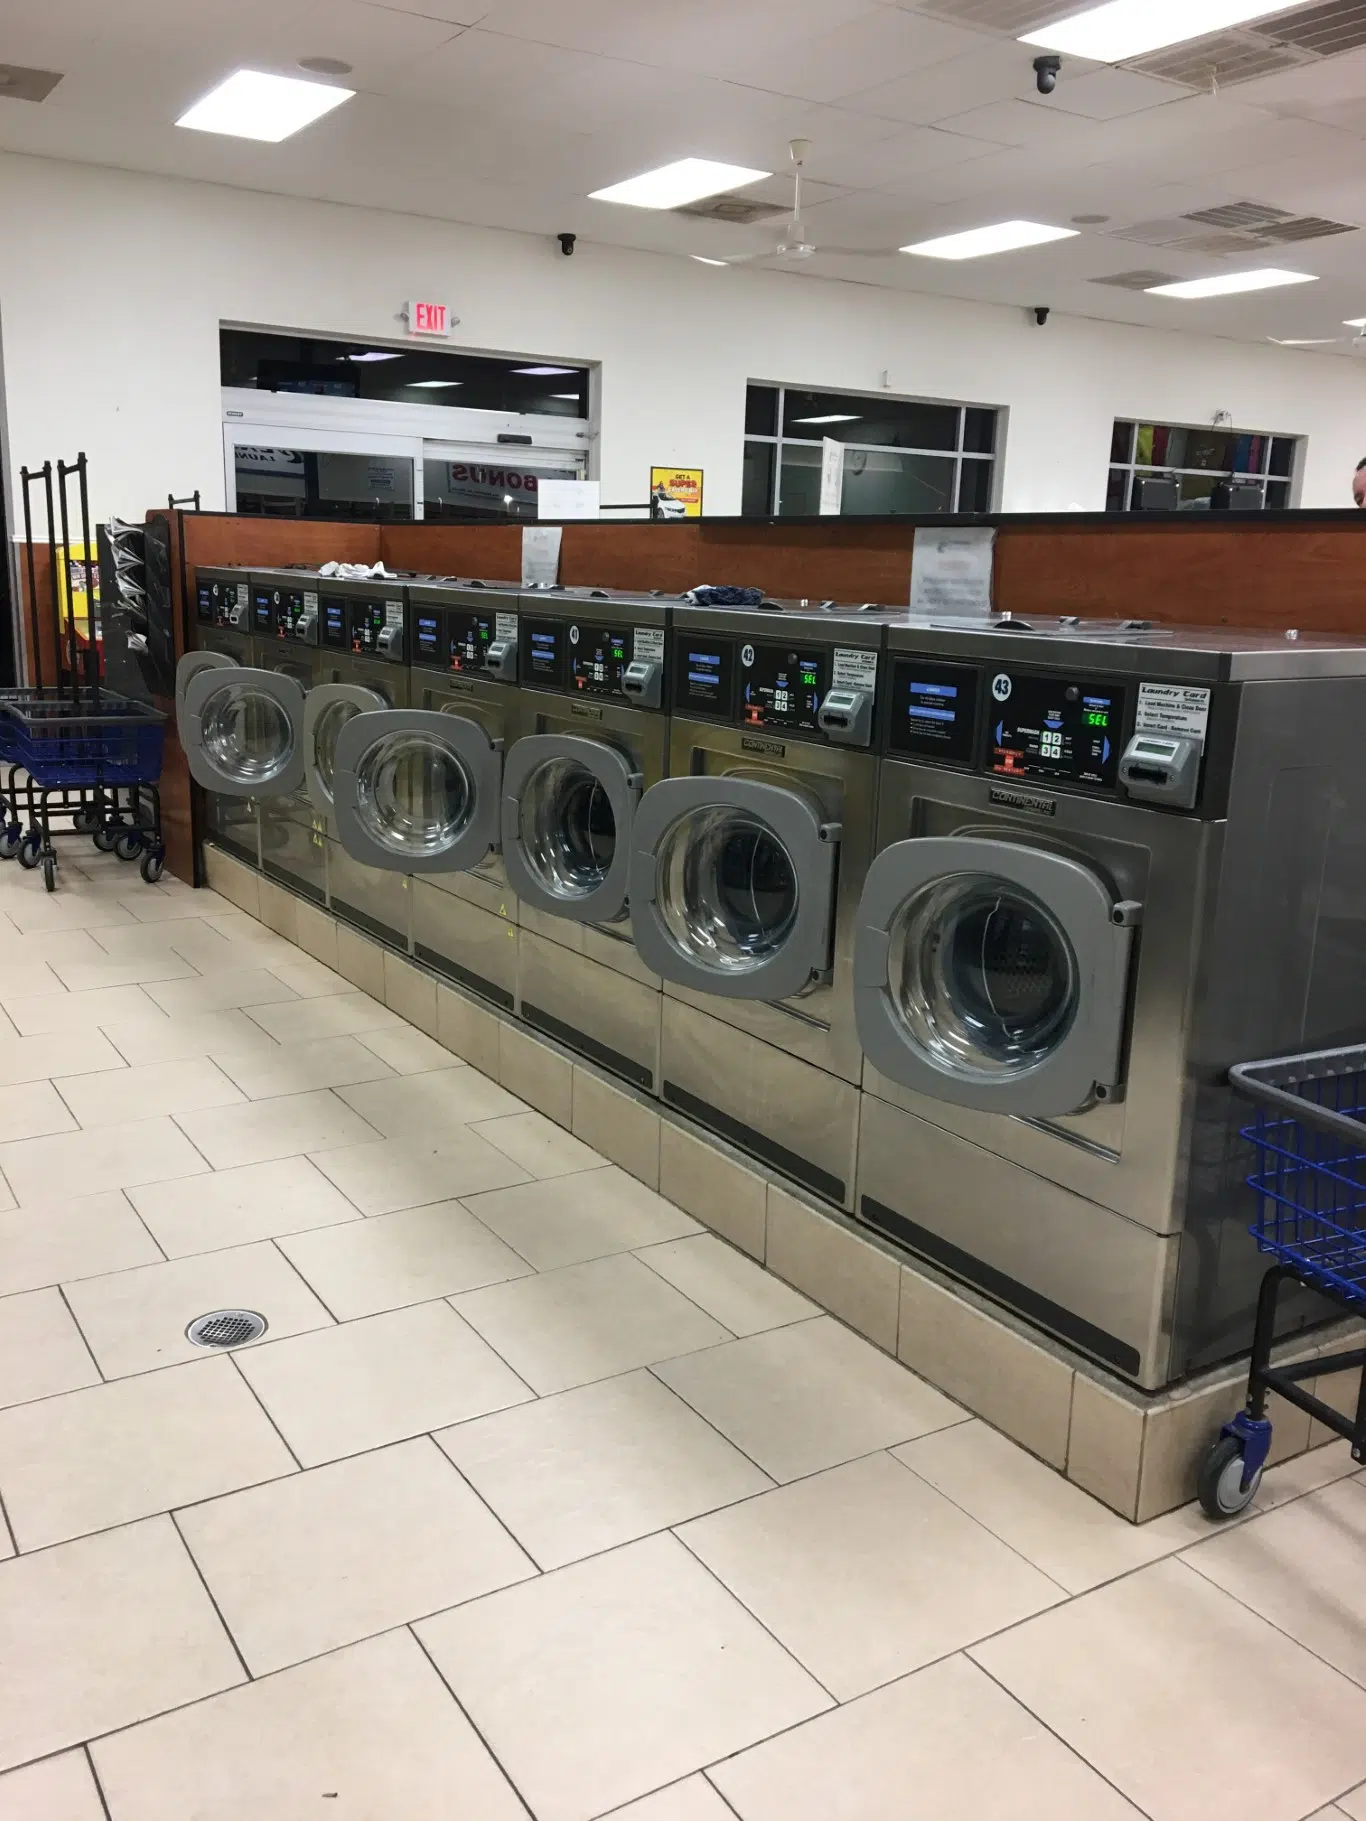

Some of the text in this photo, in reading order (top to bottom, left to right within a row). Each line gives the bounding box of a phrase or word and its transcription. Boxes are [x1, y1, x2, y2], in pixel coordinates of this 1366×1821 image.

[416, 303, 446, 331] EXIT
[743, 648, 753, 662] 42
[804, 676, 817, 685] SEL
[994, 679, 1009, 695] 43
[1142, 687, 1207, 699] Laundry Card
[1088, 713, 1108, 726] SEL
[991, 790, 1055, 811] CONTINENTAL
